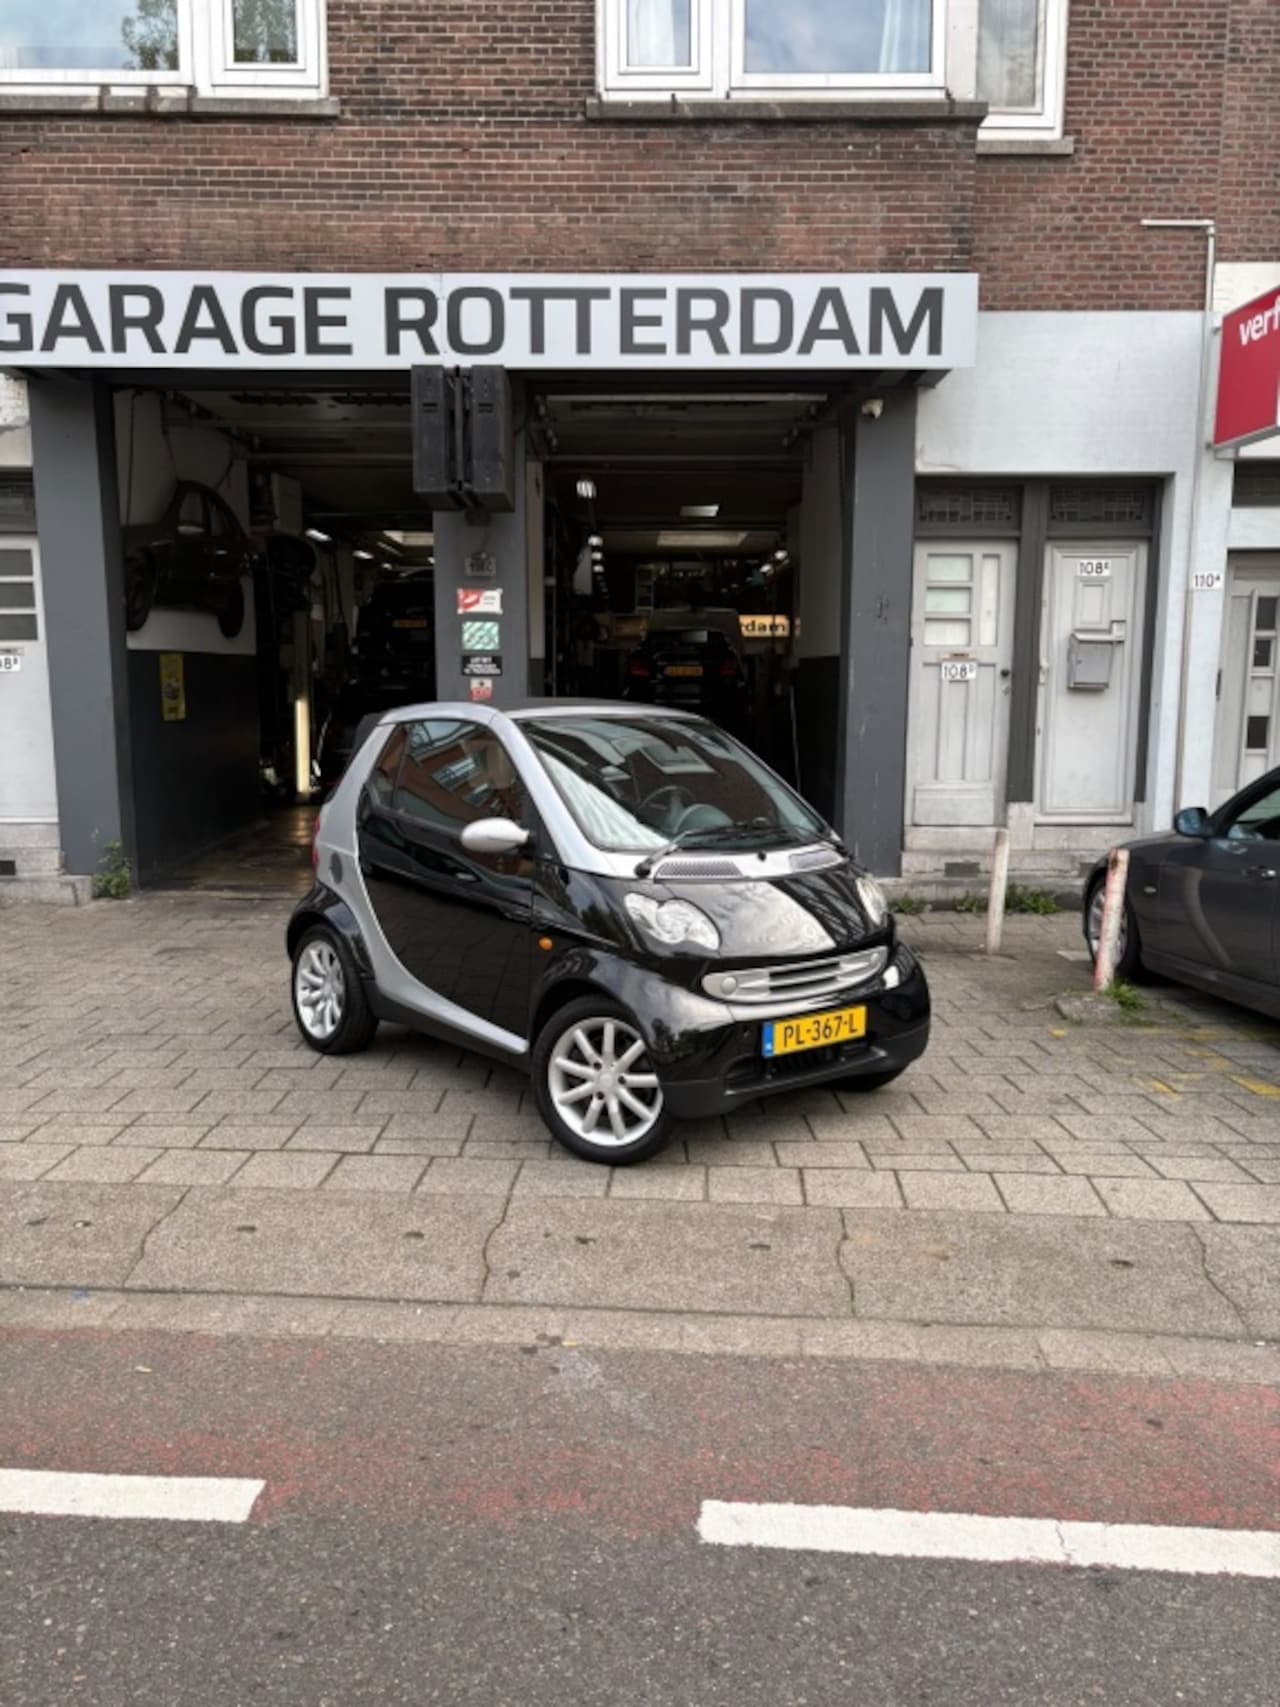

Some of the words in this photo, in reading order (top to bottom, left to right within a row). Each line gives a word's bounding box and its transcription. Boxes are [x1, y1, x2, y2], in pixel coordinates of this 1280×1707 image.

[0, 282, 353, 355] GARAGE
[384, 286, 944, 356] ROTTERDAM
[783, 1013, 858, 1048] PL-367-L
